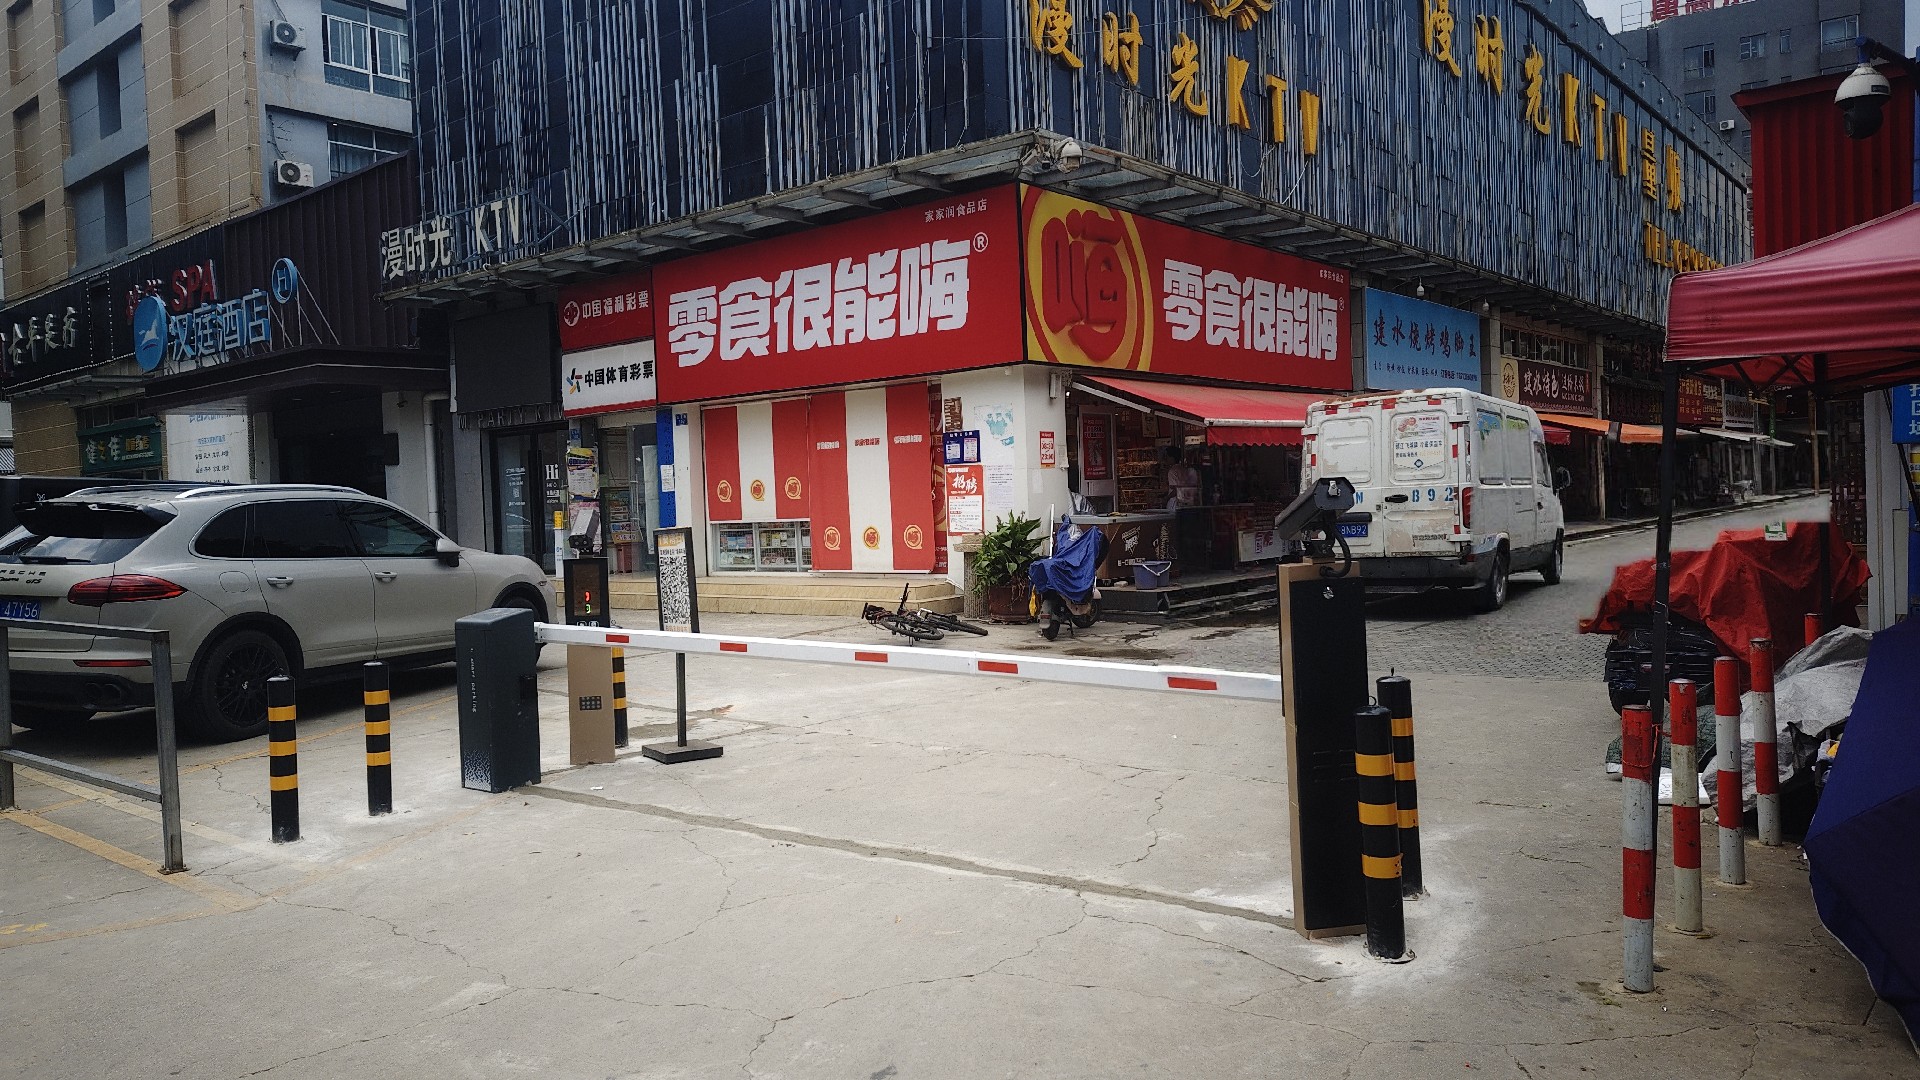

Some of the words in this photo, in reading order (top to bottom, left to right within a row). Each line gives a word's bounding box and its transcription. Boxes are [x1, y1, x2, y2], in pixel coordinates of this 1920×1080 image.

[1227, 54, 1320, 156] KTV
[1563, 72, 1628, 178] KTV
[381, 215, 453, 281] 漫时光
[474, 194, 519, 255] KTV
[924, 198, 988, 223] 家家润食品店
[171, 258, 218, 312] SPA
[582, 289, 649, 320] 中国福利彩票
[667, 238, 971, 369] 零食很能嗨
[1162, 257, 1339, 362] 零食很能嗨
[168, 288, 272, 361] 汉庭酒店
[584, 360, 654, 388] 中国体育彩票
[952, 472, 978, 494] 招聘
